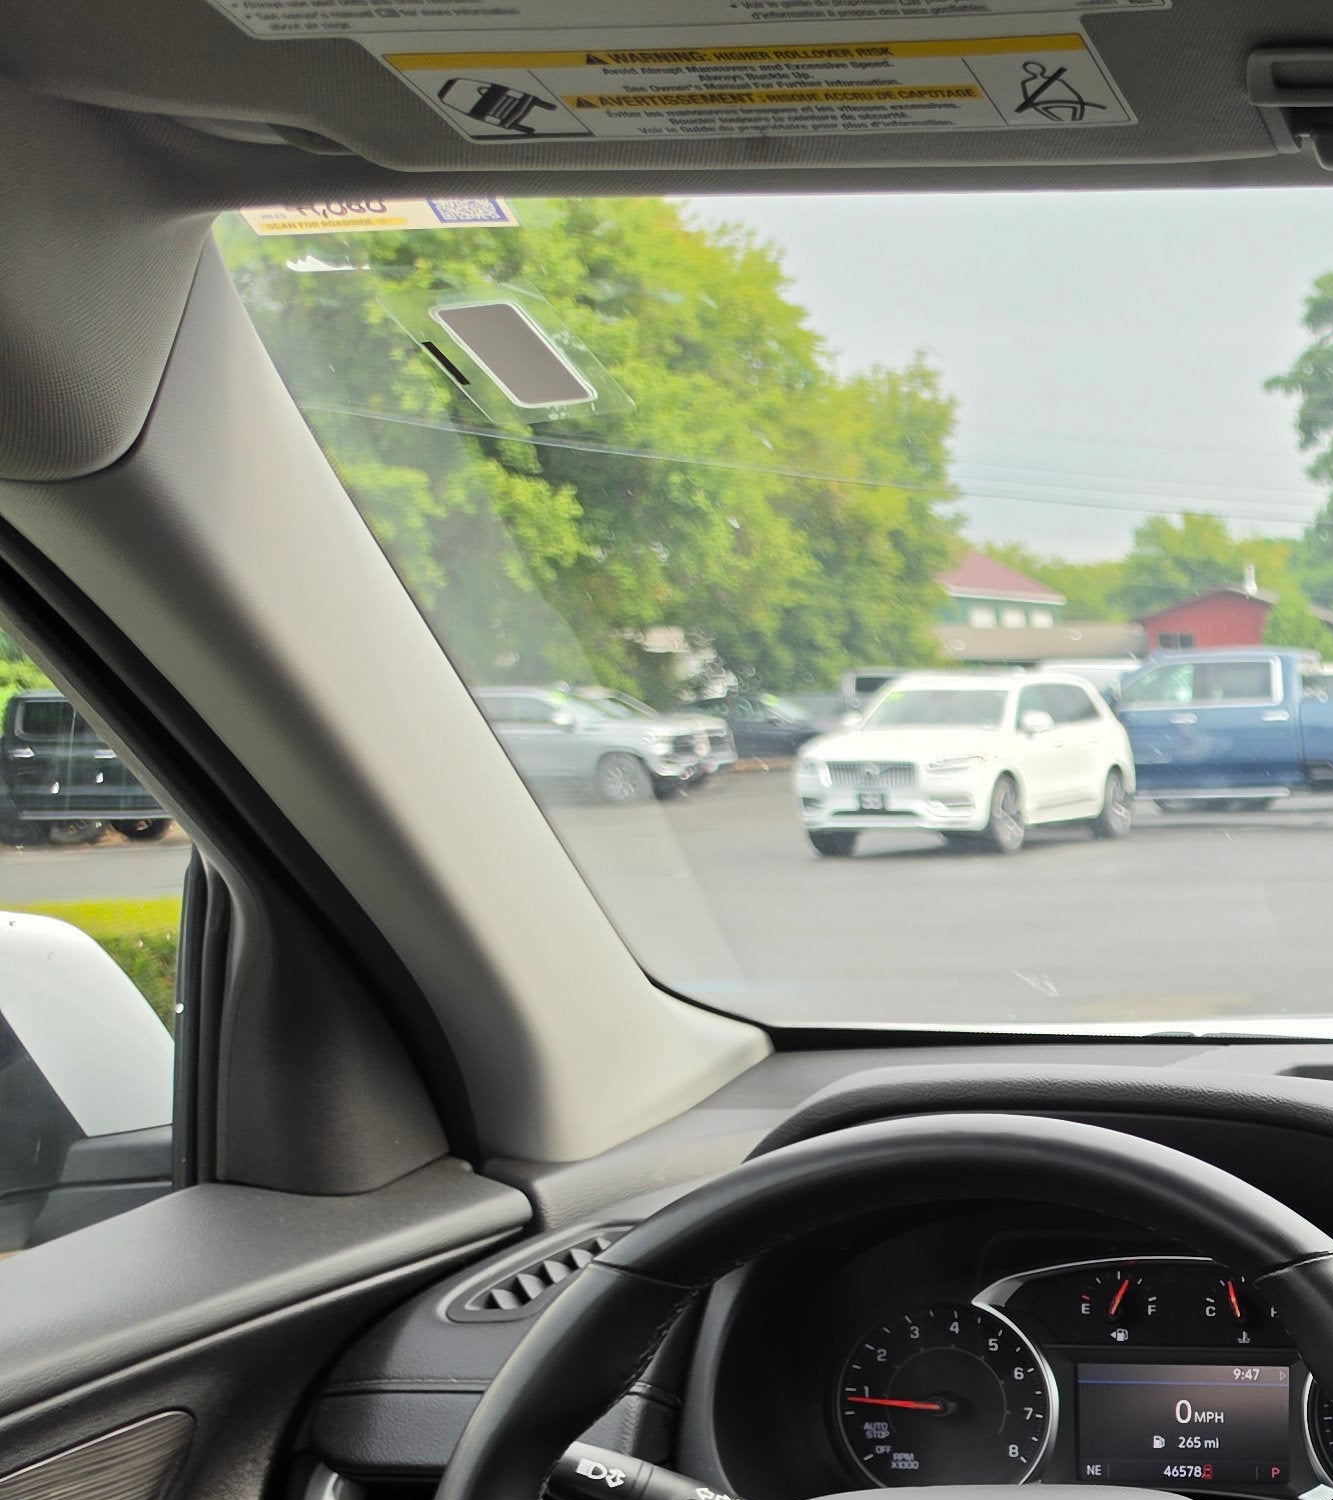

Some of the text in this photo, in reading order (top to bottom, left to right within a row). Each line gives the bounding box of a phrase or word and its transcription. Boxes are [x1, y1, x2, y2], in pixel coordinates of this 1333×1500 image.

[714, 48, 771, 62] HIGHER
[774, 48, 857, 61] ROLLOVER
[857, 46, 893, 58] RISK
[897, 87, 977, 99] CAPOTAGE
[1081, 1303, 1091, 1315] E
[1147, 1304, 1157, 1316] F
[1205, 1305, 1216, 1317] C
[909, 1326, 920, 1339] 3
[950, 1321, 960, 1334] 4
[988, 1338, 999, 1351] 5
[876, 1348, 887, 1361] 2
[1013, 1366, 1024, 1380] 6
[1232, 1368, 1261, 1381] 9:47
[1023, 1407, 1034, 1420] 7
[1175, 1399, 1224, 1424] 0 MPH
[1178, 1436, 1220, 1449] 265 mi
[1008, 1444, 1019, 1457] 8
[1086, 1464, 1102, 1476] NE
[1271, 1467, 1281, 1479] P
